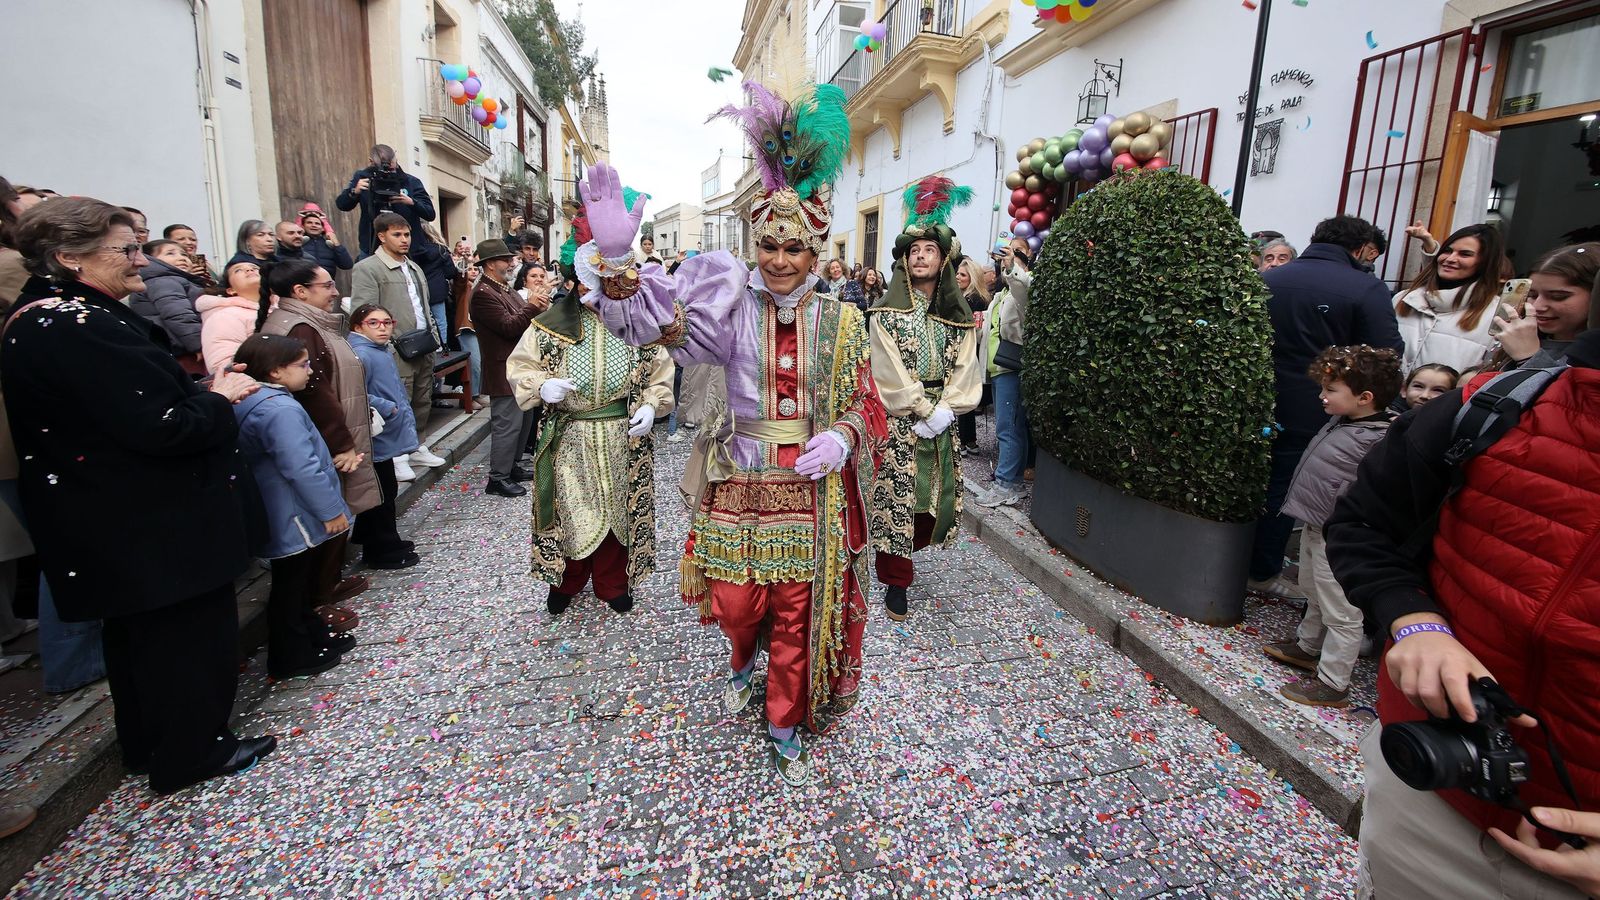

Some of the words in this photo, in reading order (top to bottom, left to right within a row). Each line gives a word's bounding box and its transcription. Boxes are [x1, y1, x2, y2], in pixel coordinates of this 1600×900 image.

[1271, 69, 1314, 88] FLAMENCA
[1265, 104, 1274, 116] DE
[1280, 96, 1302, 110] PAULA
[1395, 623, 1453, 641] LORETO
[1481, 758, 1491, 780] Canon
